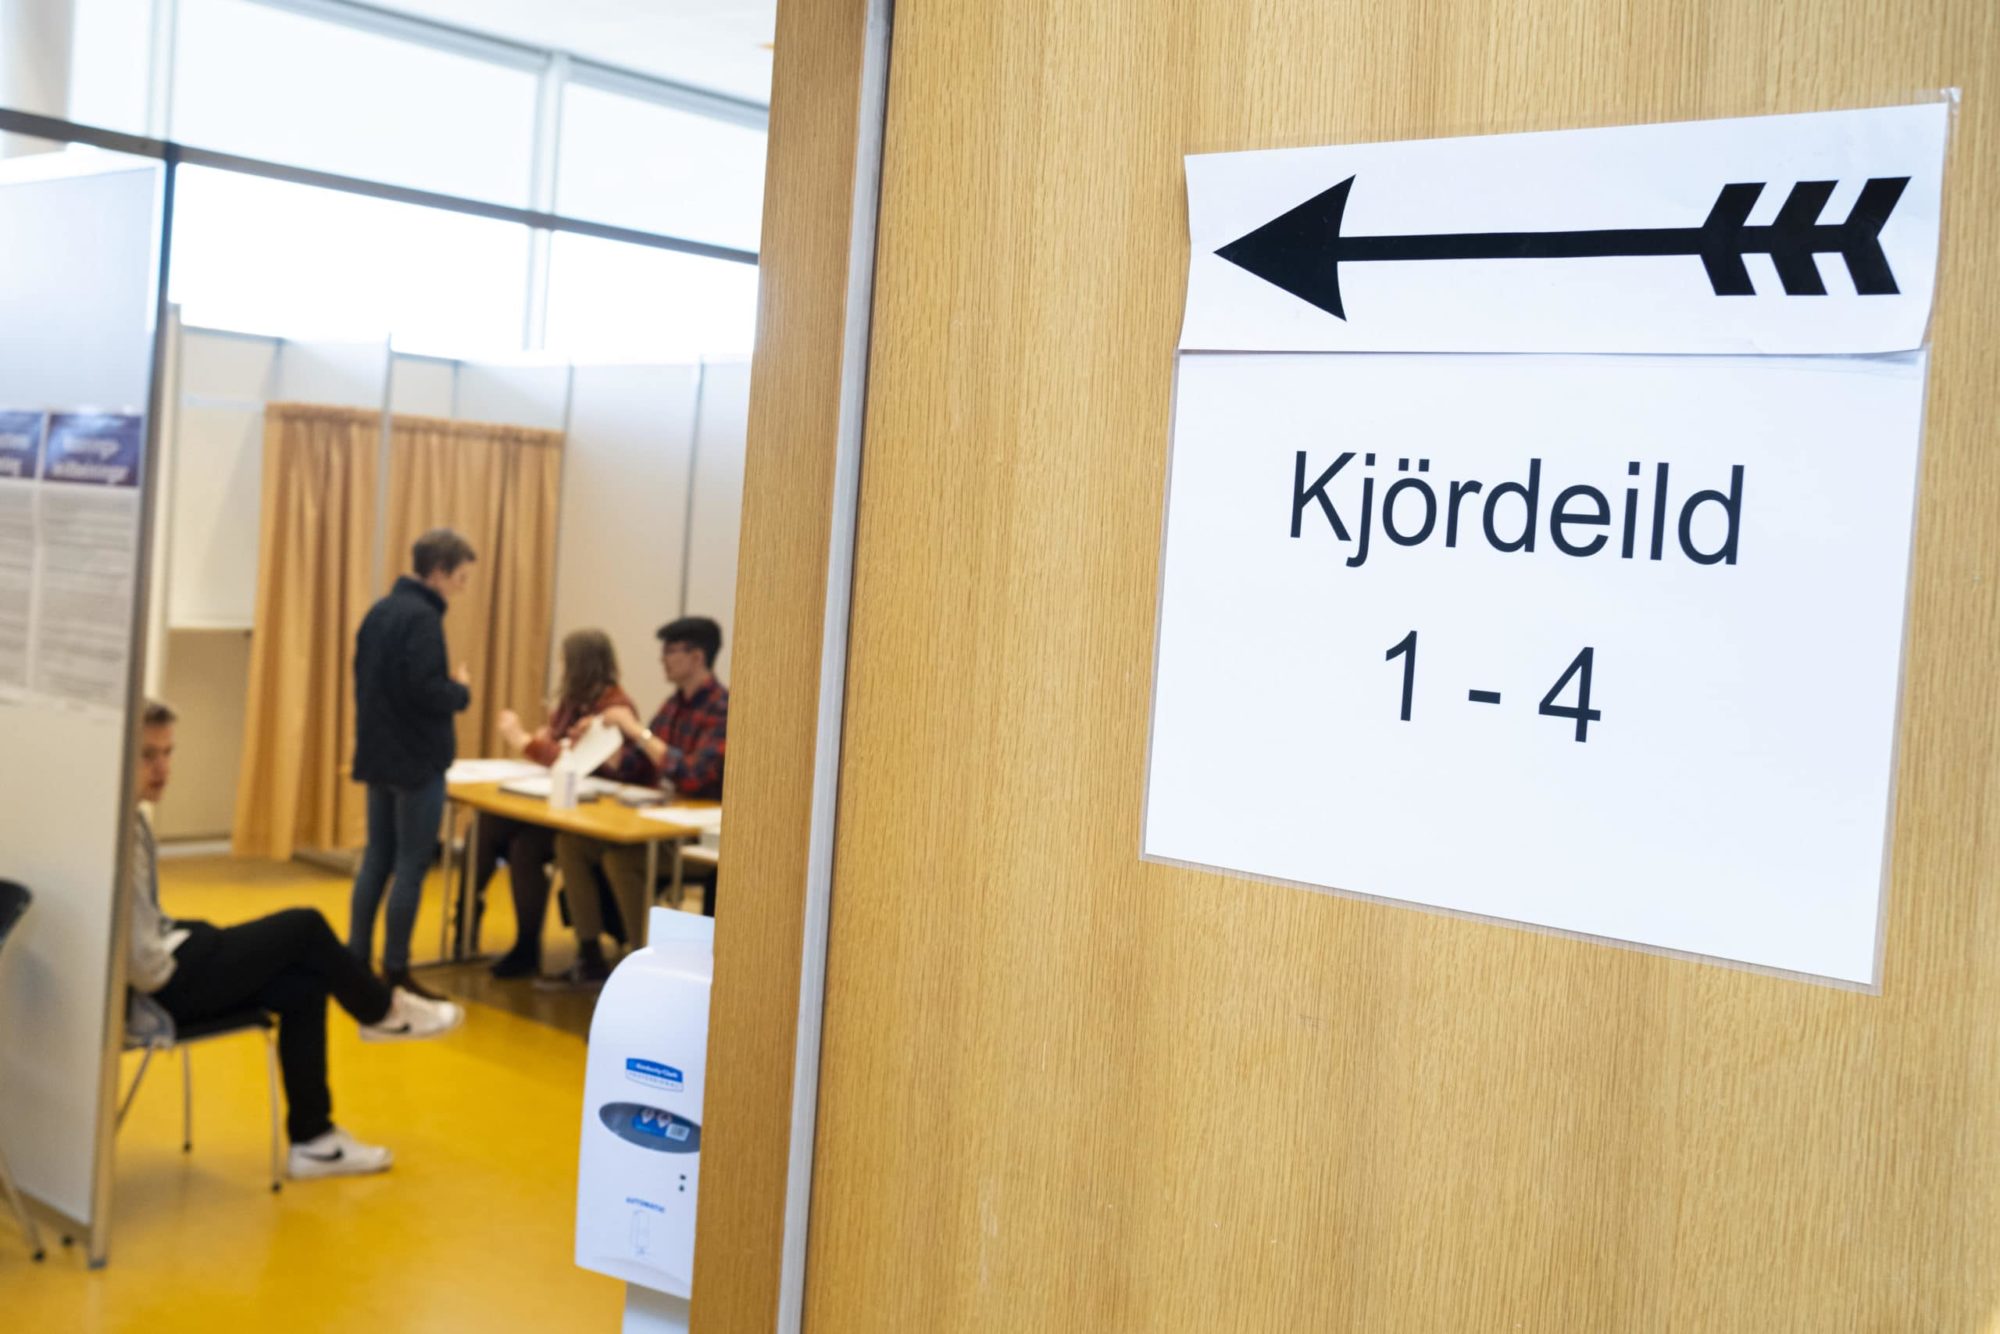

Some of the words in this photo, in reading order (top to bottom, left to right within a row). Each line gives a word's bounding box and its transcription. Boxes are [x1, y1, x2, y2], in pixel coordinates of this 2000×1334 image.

[1290, 450, 1745, 568] Kjördeild
[1384, 629, 1418, 723] 1
[1466, 688, 1502, 706] -
[1537, 645, 1602, 744] 4
